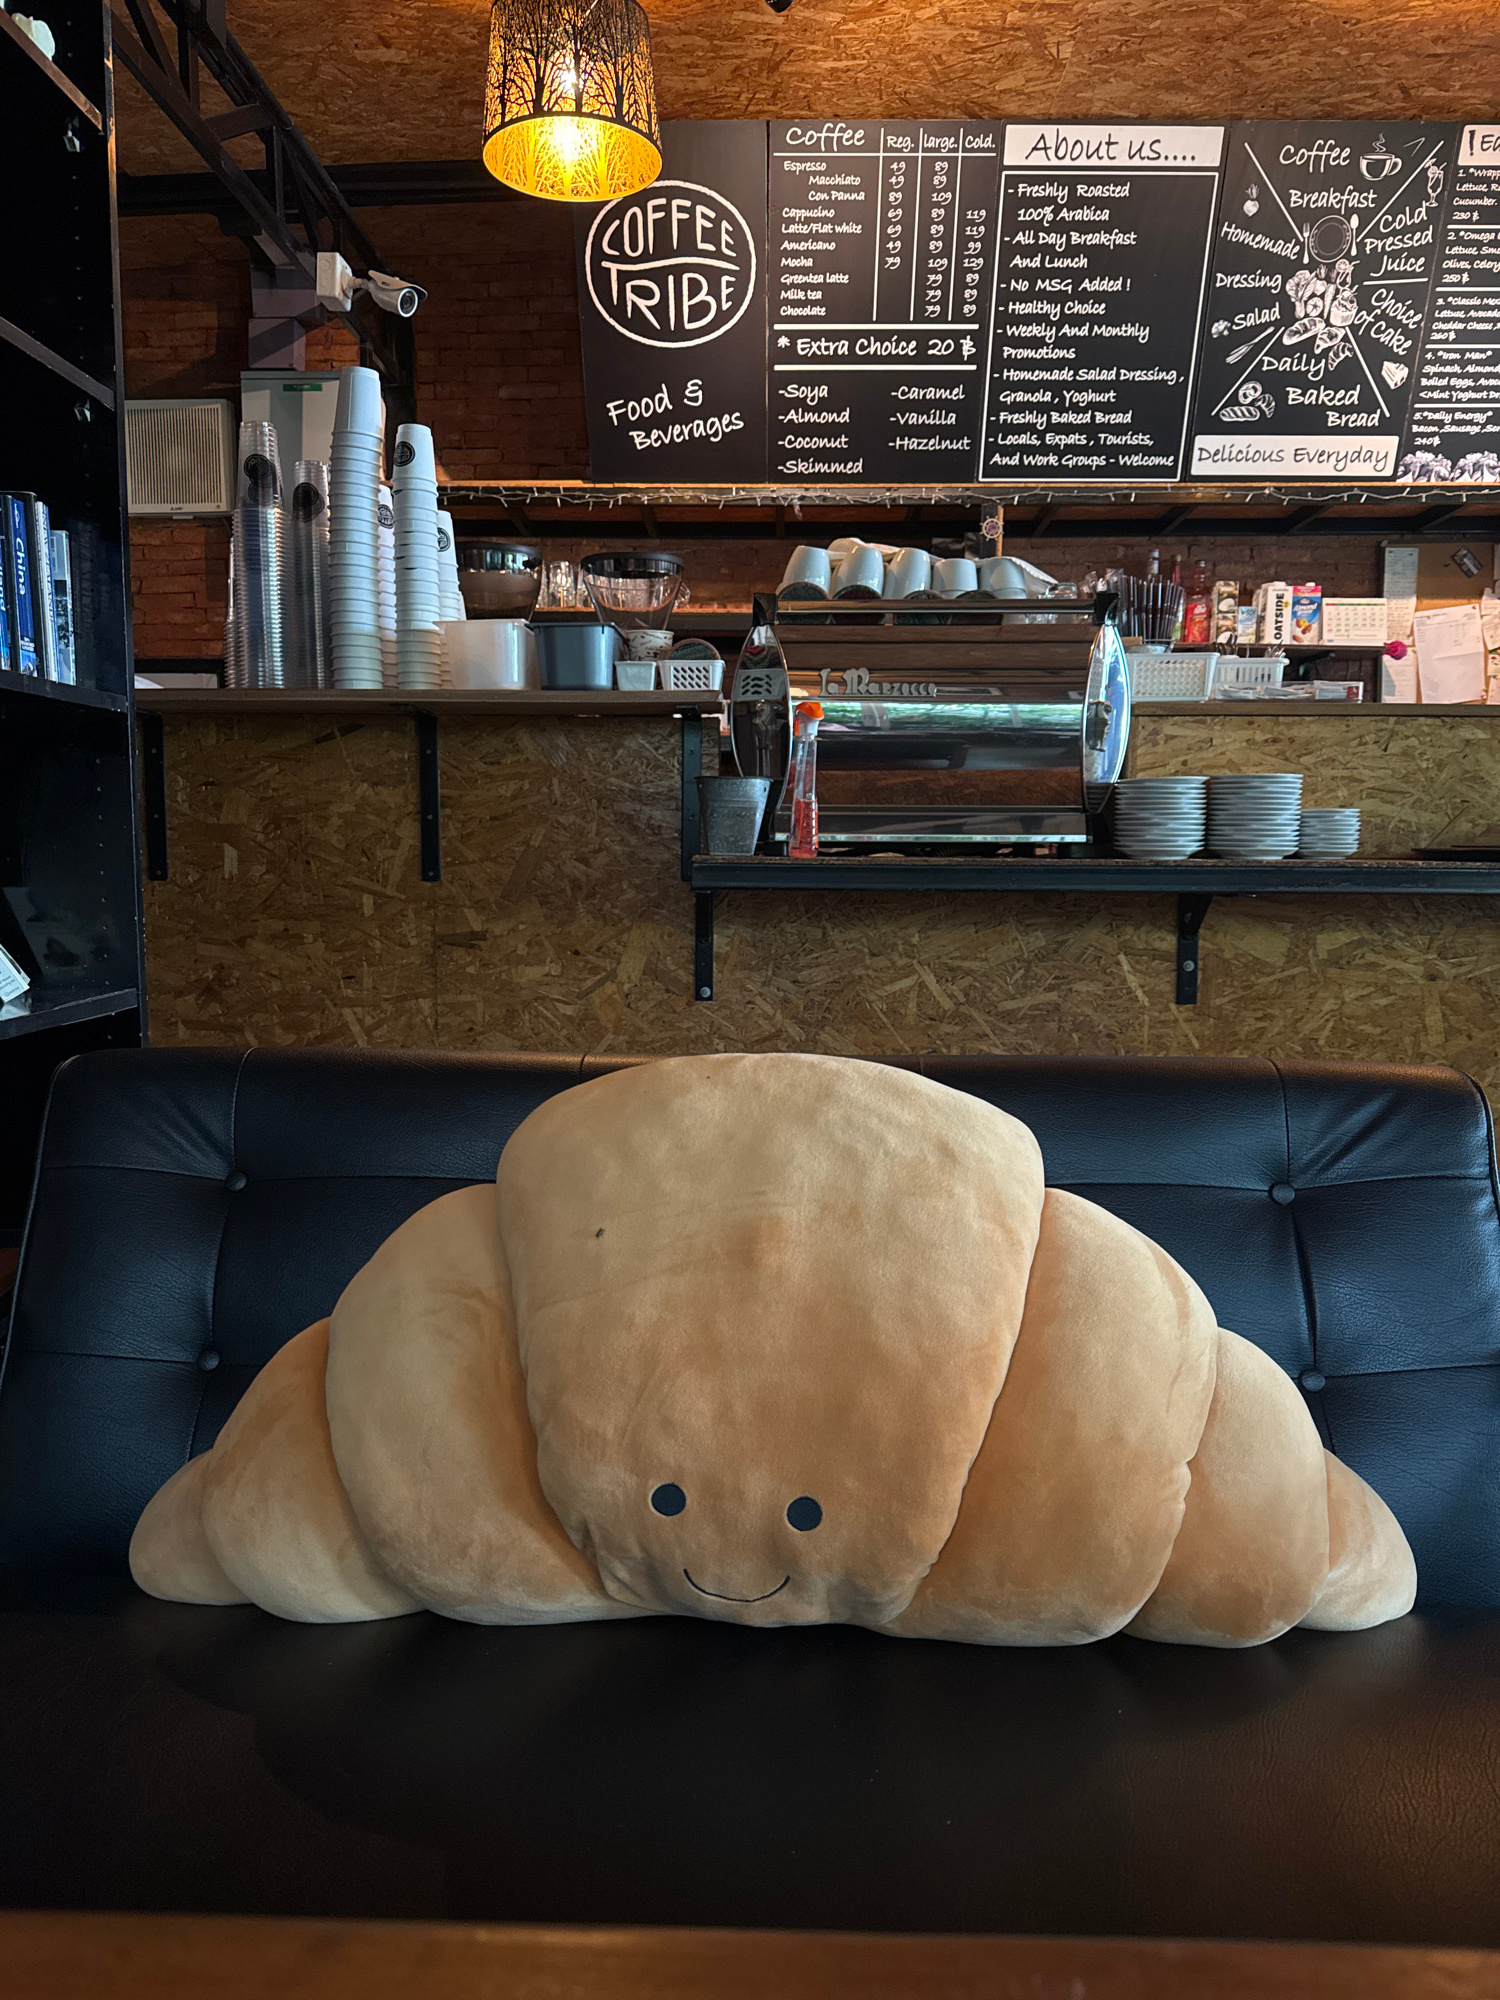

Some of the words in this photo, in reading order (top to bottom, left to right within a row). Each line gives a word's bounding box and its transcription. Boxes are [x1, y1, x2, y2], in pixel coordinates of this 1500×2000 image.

[786, 123, 865, 151] Coffee
[887, 136, 914, 152] Reg.
[924, 134, 957, 152] large.
[965, 134, 995, 148] Cold.
[1025, 128, 1118, 161] About
[1280, 140, 1350, 172] Coffee
[784, 161, 826, 173] Espresso
[891, 162, 905, 174] 49
[935, 162, 948, 174] 89
[809, 174, 860, 185] Macchiato
[889, 176, 904, 188] 49
[933, 175, 946, 188] 89
[809, 191, 829, 201] Con
[831, 191, 865, 200] Panna
[889, 192, 902, 204] 89
[932, 192, 952, 204] 109
[1018, 182, 1068, 204] Freshly
[1077, 182, 1130, 197] Roasted
[1288, 185, 1377, 216] Breakfast
[1453, 196, 1497, 205] Cucumber.
[783, 206, 835, 220] Cappucino
[888, 209, 902, 221] 69
[931, 208, 944, 221] 89
[967, 210, 986, 222] 119
[1018, 205, 1054, 226] 100%
[1056, 206, 1109, 221] Arabica
[1378, 200, 1429, 234] Cold
[601, 197, 737, 257] COFFEE
[782, 223, 833, 233] Latte/Flat
[835, 222, 862, 233] white
[887, 225, 901, 237] 69
[930, 225, 944, 237] 89
[966, 226, 985, 238] 119
[780, 239, 836, 250] Americano
[886, 241, 901, 253] 49
[929, 241, 942, 253] 89
[964, 242, 981, 254] 99
[1012, 230, 1035, 244] All
[1039, 232, 1066, 251] Day
[1070, 229, 1137, 249] Breakfast
[1221, 220, 1301, 259] Homemade
[1364, 224, 1432, 255] Pressed
[781, 256, 813, 267] Mocha
[885, 257, 900, 269] 79
[928, 258, 948, 271] 109
[963, 258, 983, 270] 129
[1010, 253, 1041, 268] And
[1045, 254, 1087, 268] Lunch
[1369, 252, 1425, 276] Juice
[1443, 259, 1471, 269] Olives,
[781, 273, 824, 285] Greentea
[826, 273, 849, 283] latte
[927, 274, 942, 286] 79
[966, 273, 979, 286] 89
[1011, 279, 1029, 291] No
[1036, 279, 1072, 294] MSG
[1078, 277, 1122, 291] Added
[1216, 270, 1281, 293] Dressing
[601, 256, 740, 331] TRIBE
[780, 288, 805, 300] Milk
[806, 288, 822, 300] tea
[926, 290, 941, 302] 79
[964, 289, 977, 301] 89
[780, 305, 826, 316] Chocolate
[925, 305, 940, 317] 79
[963, 305, 976, 316] 89
[1009, 300, 1060, 320] Healthy
[1065, 300, 1105, 314] Choice
[1232, 302, 1282, 332] Salad
[1370, 288, 1423, 330] Choice
[1007, 323, 1056, 343] Weekly
[1058, 322, 1089, 336] And
[1092, 323, 1149, 343] Monthly
[1354, 309, 1380, 336] of
[1369, 320, 1414, 355] Cake
[1431, 320, 1467, 330] Cheddar
[797, 338, 848, 356] Extra
[856, 336, 916, 355] Choice
[928, 339, 954, 355] 20
[1003, 345, 1075, 359] Promotions
[1003, 367, 1073, 381] Homemade
[1076, 367, 1116, 380] Salad
[1261, 352, 1327, 381] Daily
[1421, 377, 1448, 386] Boiled
[607, 384, 672, 426] Food
[684, 379, 702, 406] &
[1063, 389, 1116, 407] Yoghurt
[1286, 385, 1360, 406] Baked
[1451, 390, 1488, 401] Yoghurt
[999, 411, 1047, 430] Freshly
[1050, 410, 1091, 424] Baked
[1094, 410, 1132, 424] Bread
[1326, 409, 1380, 427] Bread
[628, 410, 744, 449] Beverages
[998, 432, 1041, 446] Locals,
[1098, 432, 1153, 446] Tourists,
[990, 453, 1019, 465] And
[1024, 453, 1058, 466] Work
[1062, 455, 1106, 470] Groups
[1119, 454, 1174, 466] Welcome
[1199, 444, 1284, 463] Delicious
[1294, 446, 1388, 472] Everyday
[15, 536, 26, 595] China
[1273, 592, 1285, 640] OATSIDE
[1292, 602, 1318, 612] Almond
